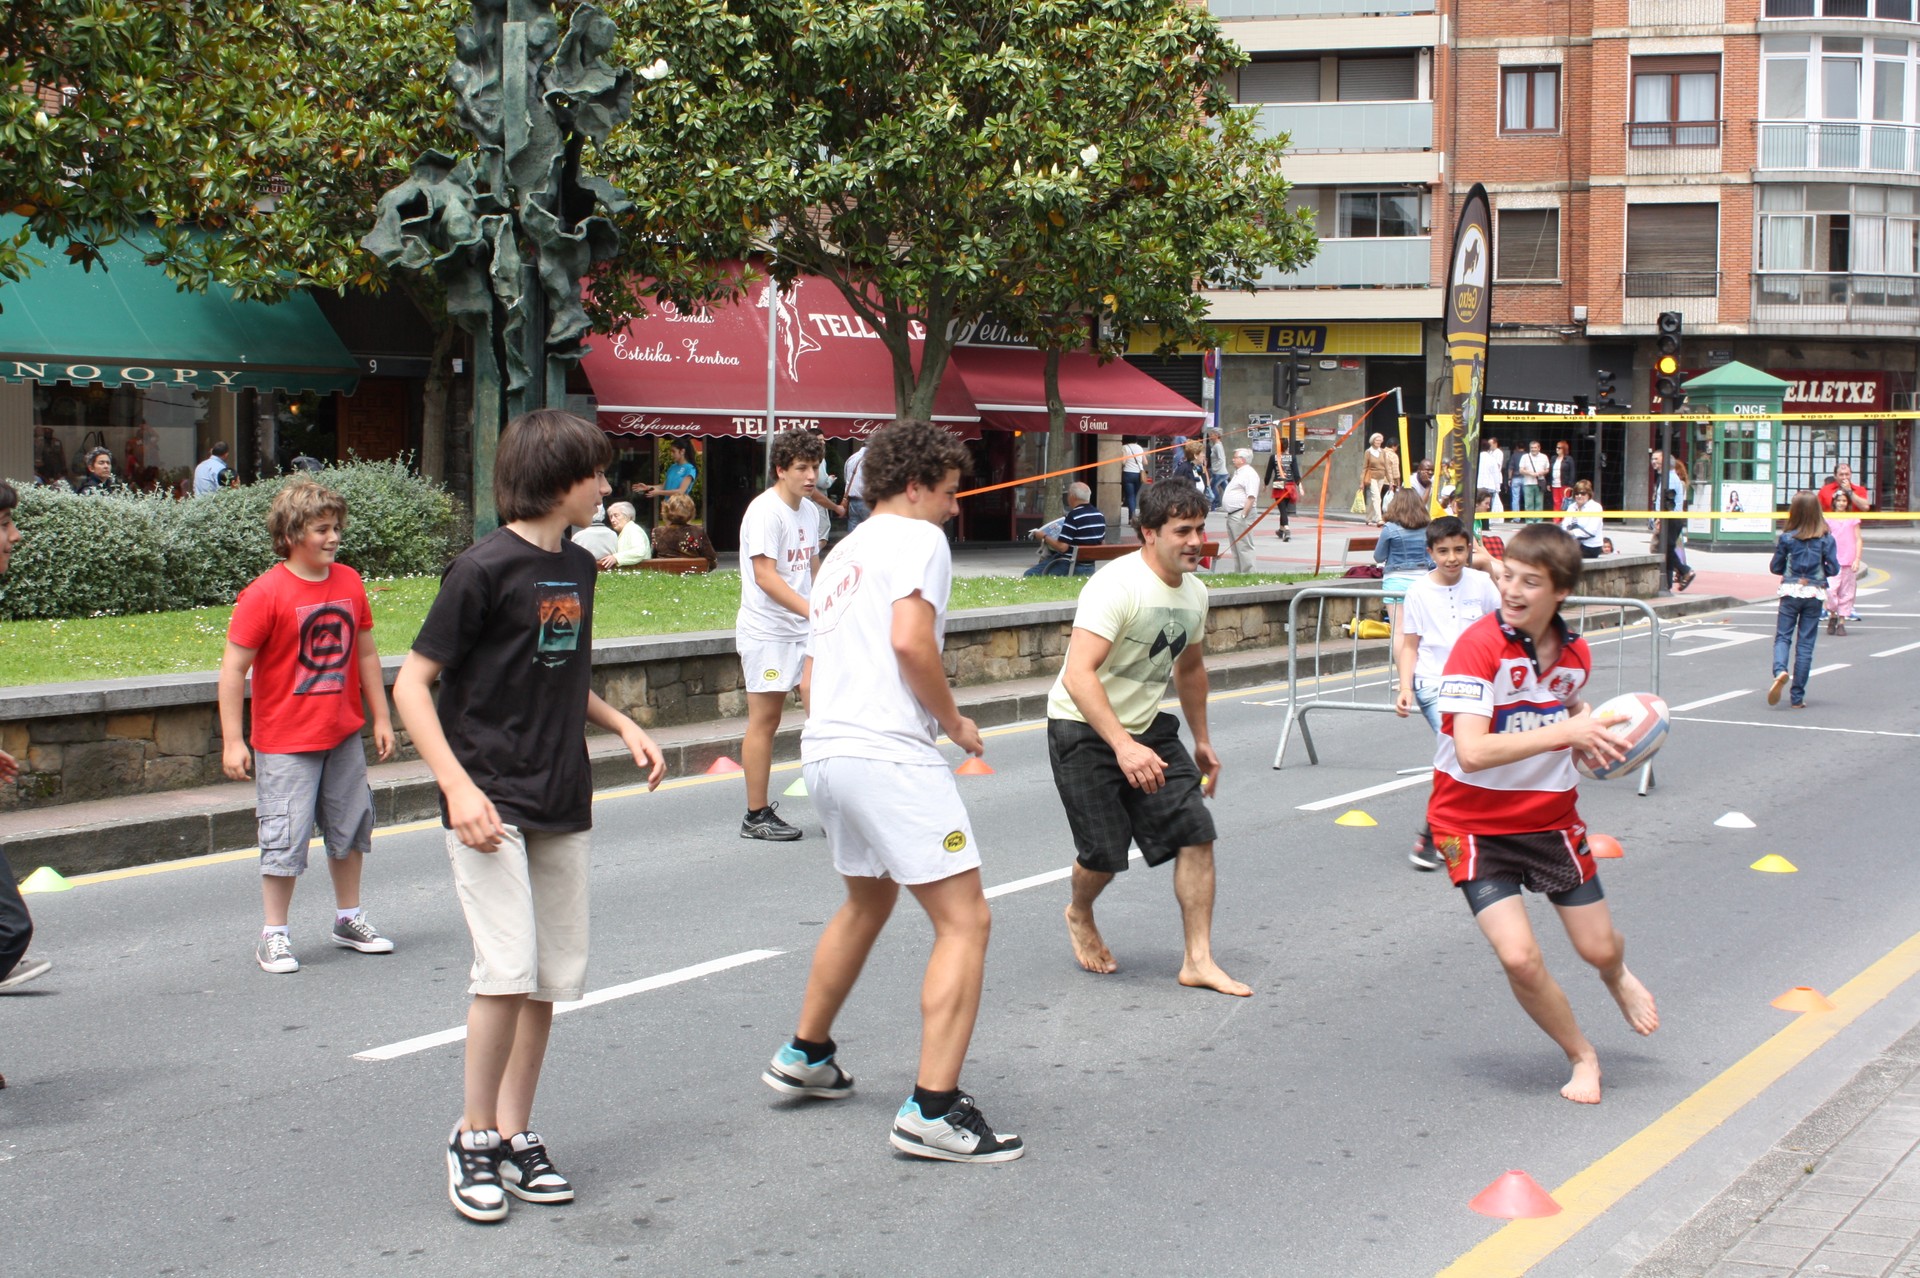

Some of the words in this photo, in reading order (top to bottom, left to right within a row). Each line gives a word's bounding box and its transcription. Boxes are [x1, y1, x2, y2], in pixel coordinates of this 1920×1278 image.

[1277, 329, 1317, 347] BM
[609, 334, 672, 363] Estetika
[682, 338, 740, 366] Zentroa
[369, 359, 377, 374] 9
[1492, 399, 1530, 412] TXELI
[1733, 404, 1767, 415] ONCE
[1079, 415, 1108, 432] Teima
[1440, 682, 1482, 696] JEWSON
